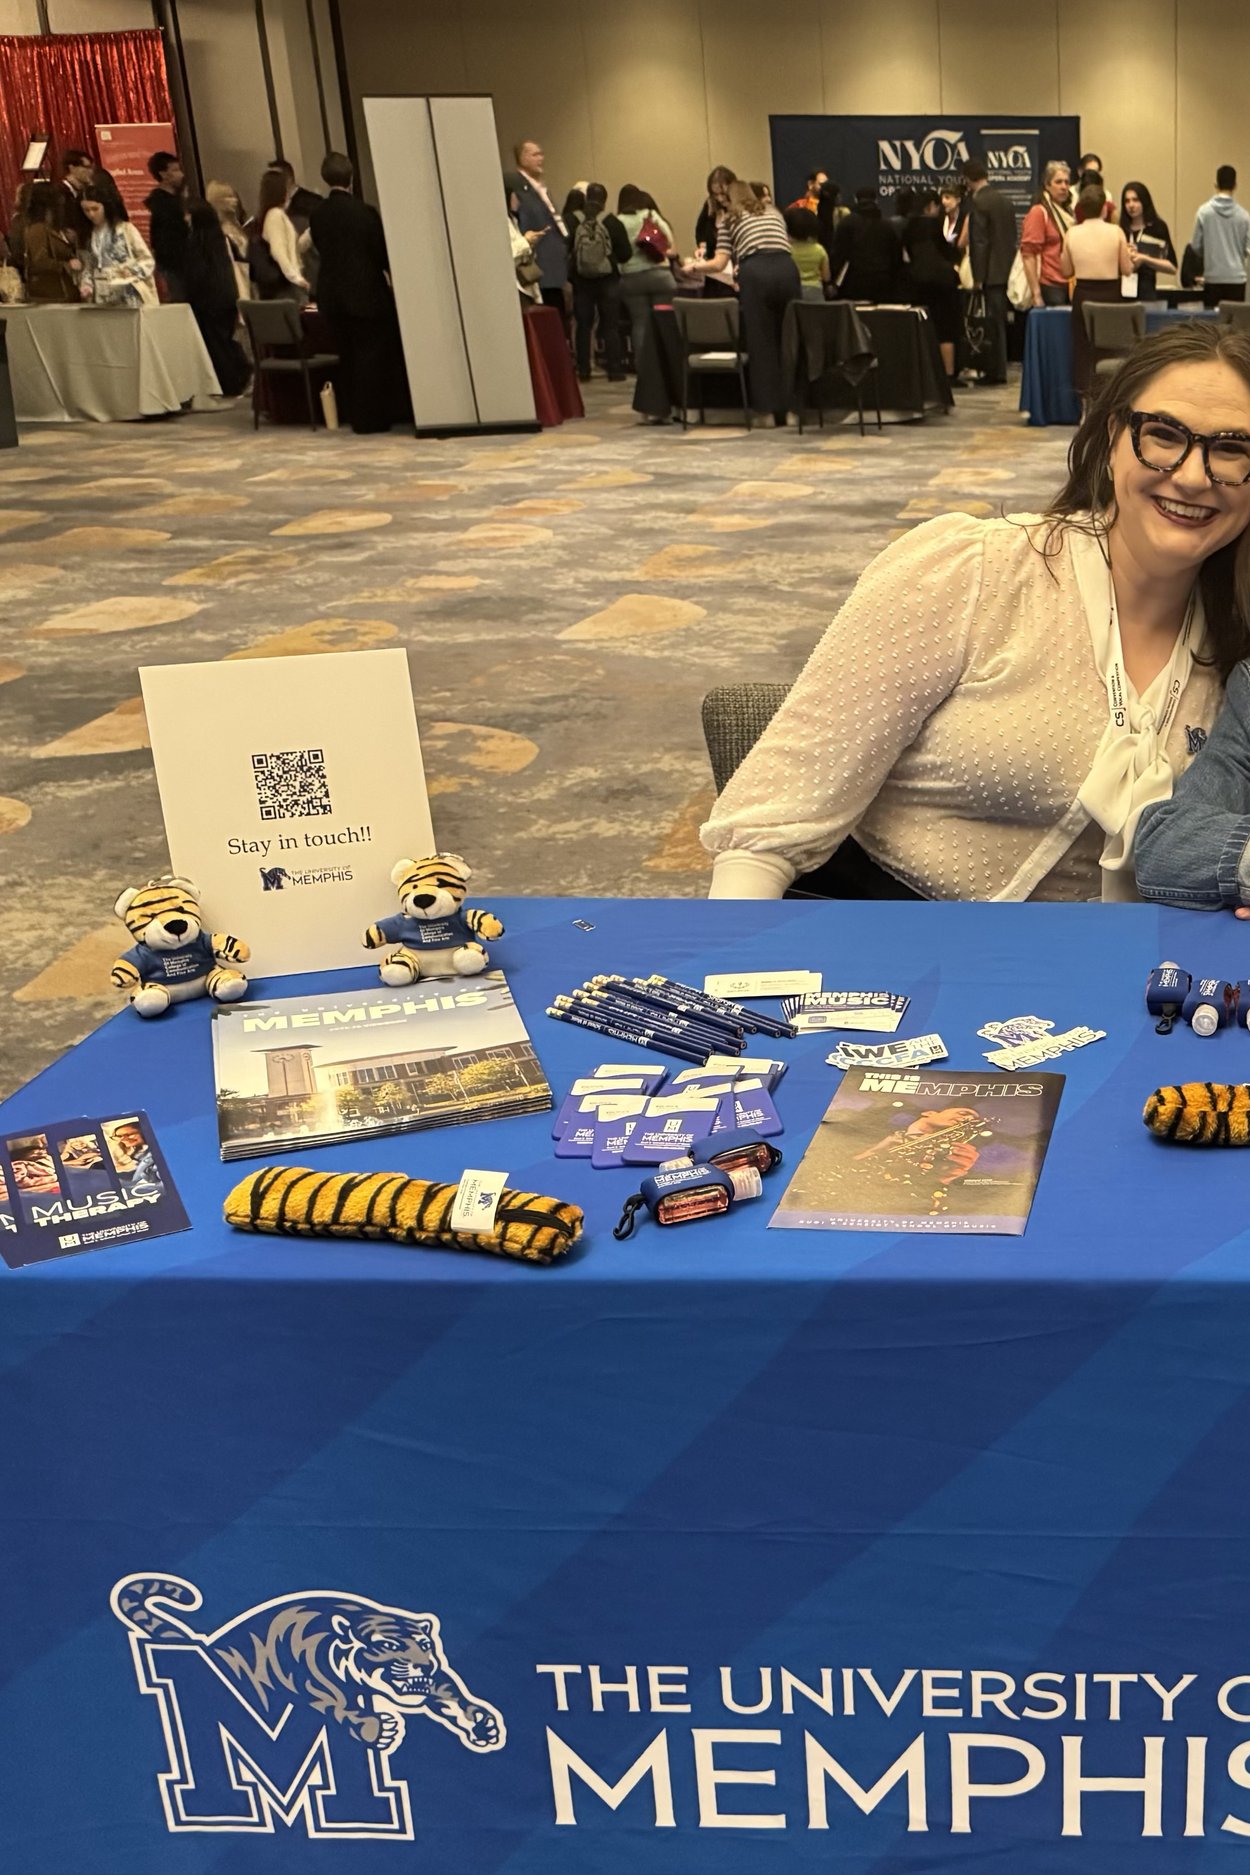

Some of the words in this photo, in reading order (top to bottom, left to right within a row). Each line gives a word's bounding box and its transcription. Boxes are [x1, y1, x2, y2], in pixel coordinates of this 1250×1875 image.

[878, 130, 970, 171] NYOA
[987, 146, 1031, 168] NYOA
[879, 175, 933, 185] NATIONAL
[938, 175, 968, 185] YOUT
[228, 838, 272, 857] Stay
[279, 834, 298, 850] in
[304, 825, 372, 847] touch!!
[292, 870, 354, 886] MEMPHIS
[243, 991, 488, 1033] MEMPHIS
[804, 996, 890, 1006] MUSIC
[1000, 1031, 1097, 1068] MEMPHIS
[859, 1078, 1043, 1097] MEMPHIS
[864, 1072, 901, 1081] THIS
[903, 1074, 921, 1082] IS
[641, 1134, 694, 1143] MEMPHIS
[31, 1183, 158, 1219] MUSIC
[33, 1193, 162, 1228] THERAPY
[536, 1664, 692, 1714] THE
[719, 1666, 1198, 1721] UNIVERSITY
